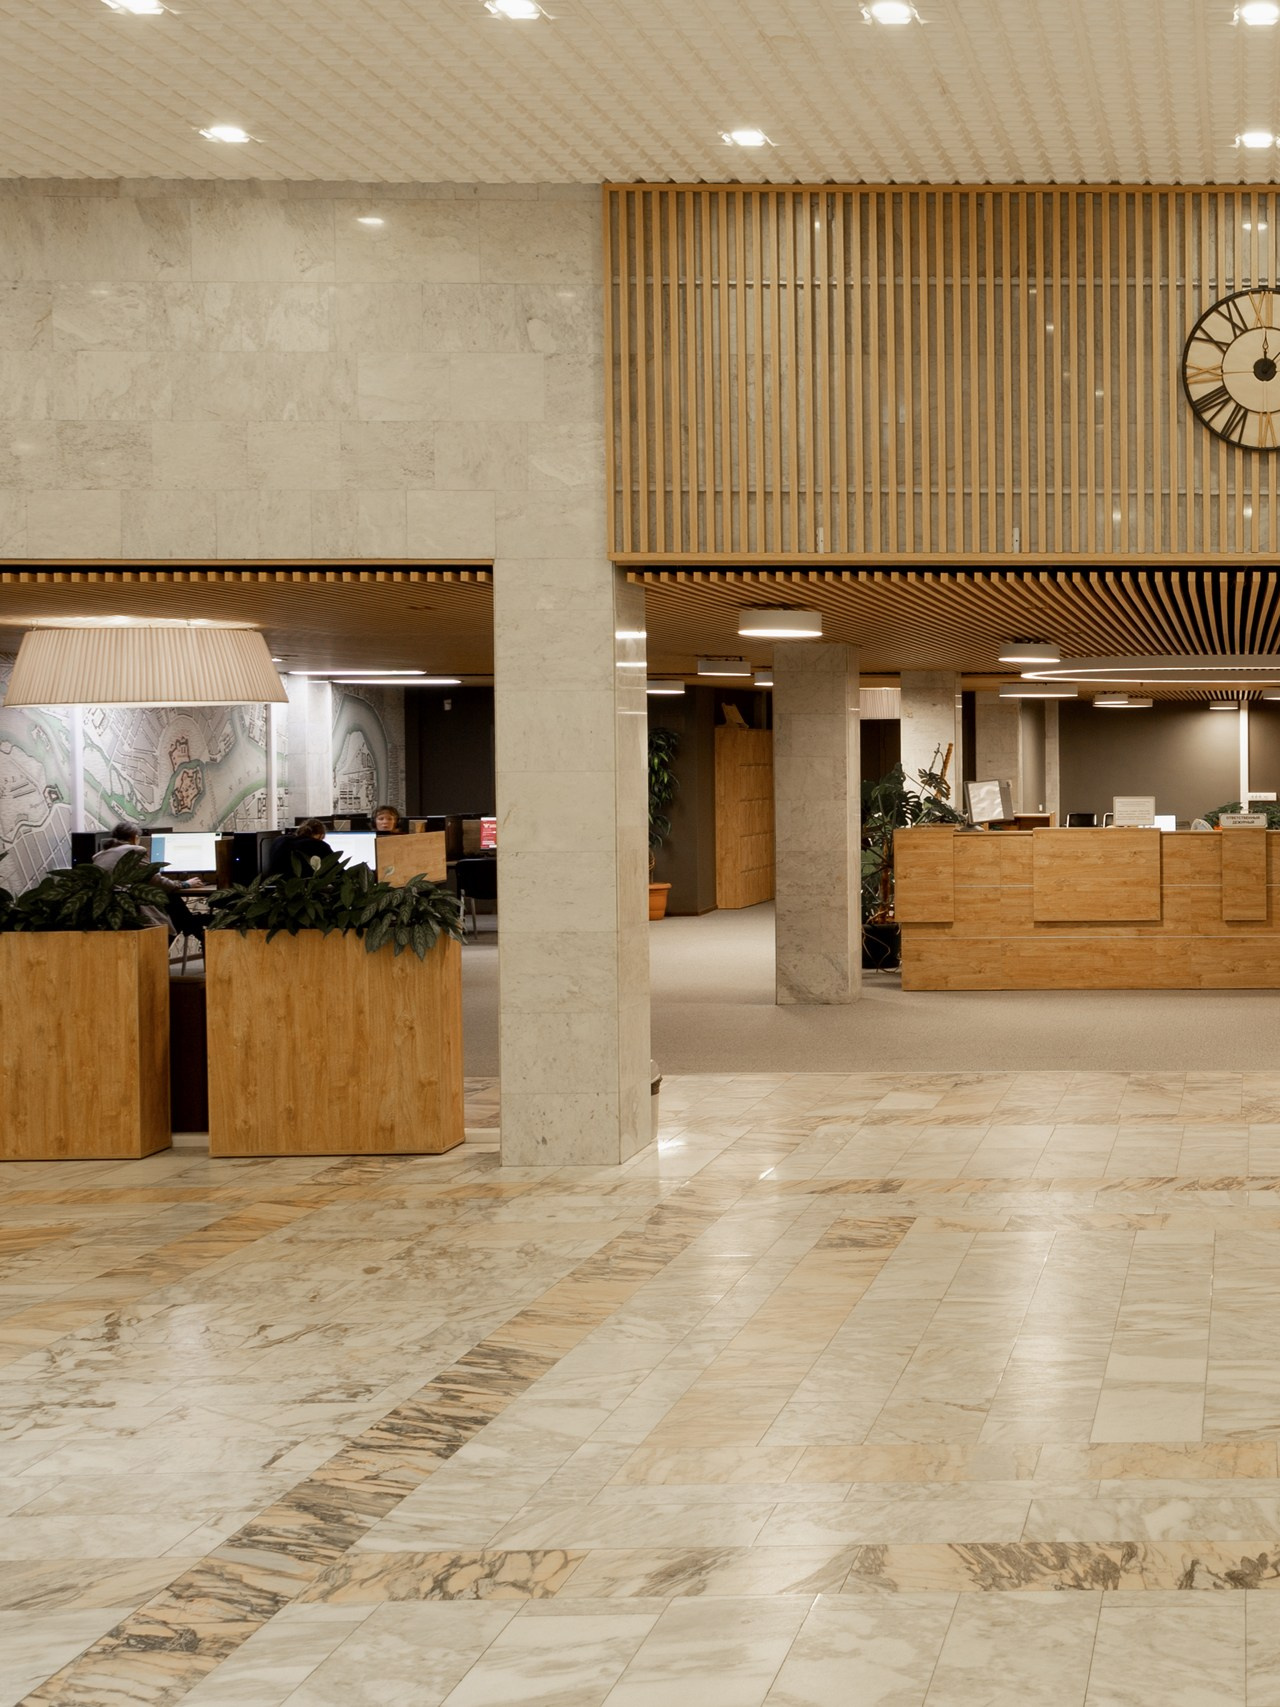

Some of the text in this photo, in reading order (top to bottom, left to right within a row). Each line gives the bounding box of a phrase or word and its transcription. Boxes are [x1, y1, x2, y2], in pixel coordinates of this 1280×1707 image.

[1214, 299, 1249, 339] XI
[1248, 291, 1274, 328] XII
[1193, 325, 1231, 354] X
[1186, 362, 1223, 384] IX
[1193, 385, 1232, 424] VIII
[1220, 403, 1249, 445] VII
[1258, 412, 1278, 448] VI
